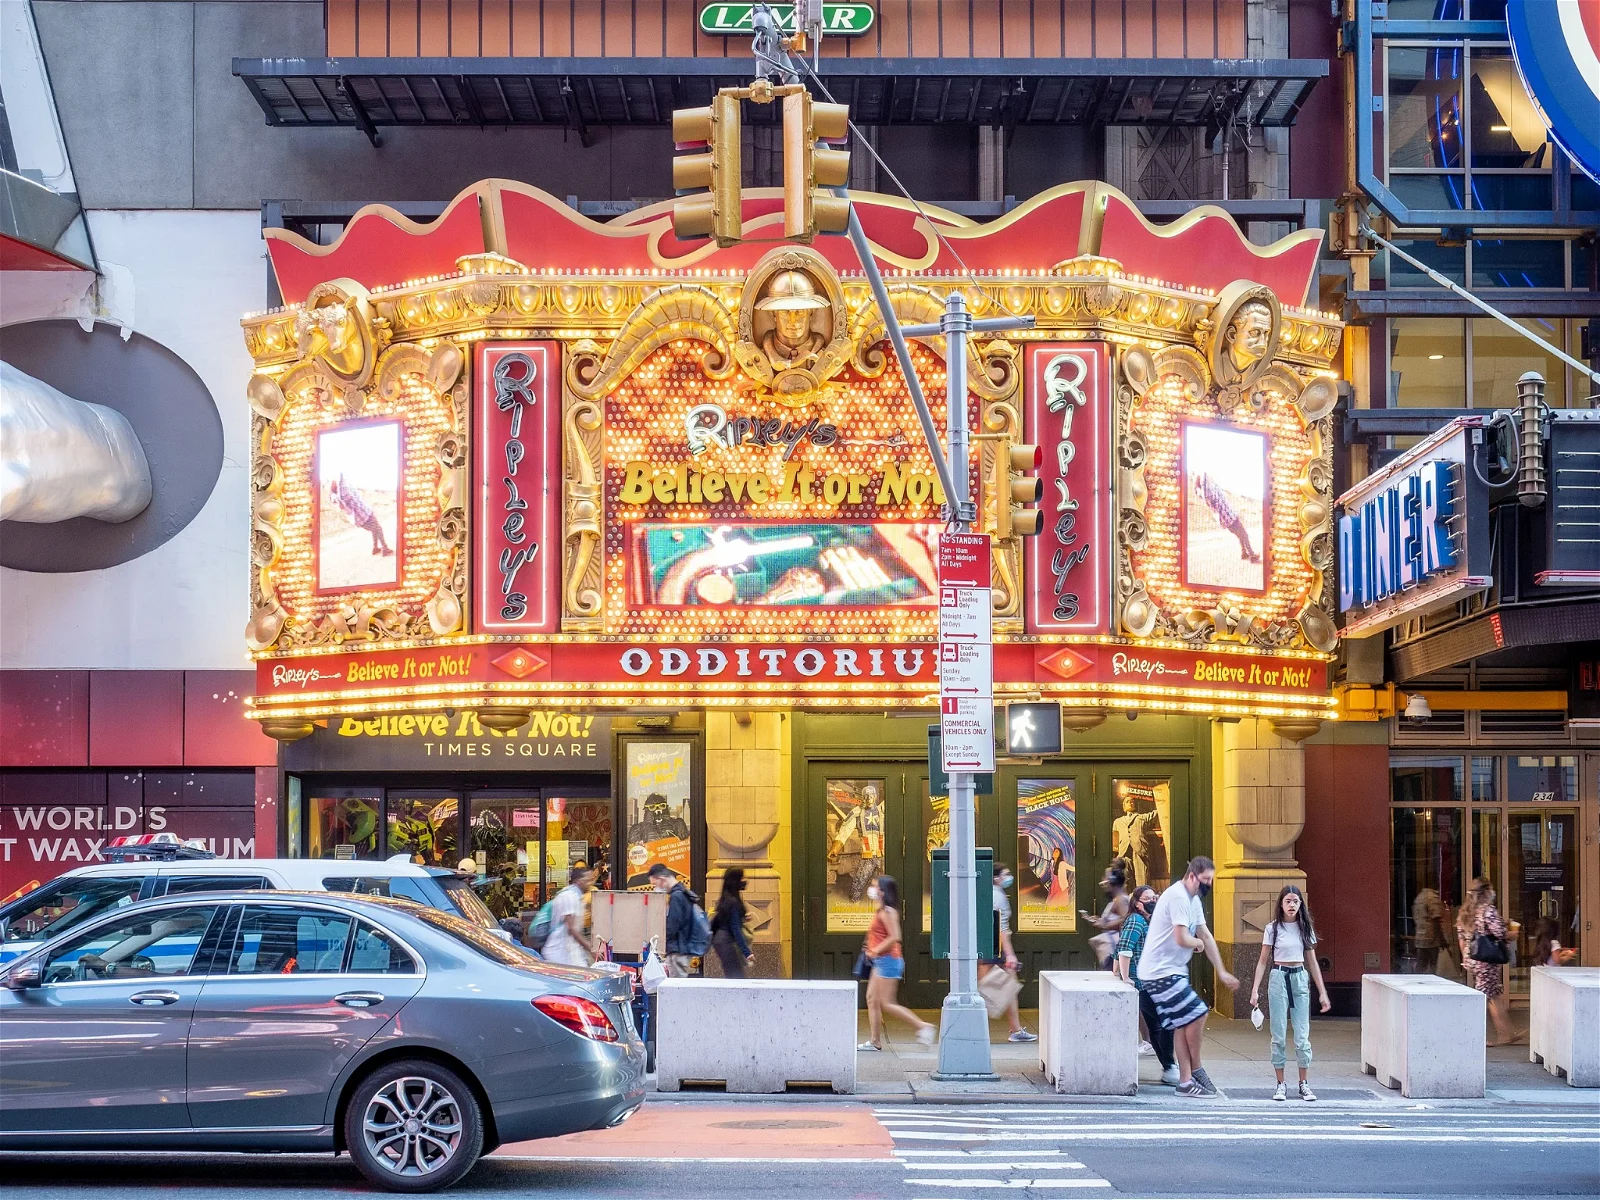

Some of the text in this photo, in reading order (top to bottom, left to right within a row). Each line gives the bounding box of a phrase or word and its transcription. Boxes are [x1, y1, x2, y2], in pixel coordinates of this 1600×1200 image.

[715, 8, 856, 29] LAMR
[684, 403, 837, 462] Ripley's
[493, 352, 539, 620] Ripley's
[618, 460, 772, 505] Believe
[773, 460, 815, 504] It
[823, 470, 871, 505] or
[1043, 353, 1090, 621] Ripley's
[941, 536, 983, 545] NO STANDING
[1339, 460, 1456, 613] DINER
[272, 652, 472, 689] Ripley's Believe It or Not!
[619, 647, 941, 676] ODDITORIU
[1112, 652, 1312, 688] Ripley's Believe It or Not!
[947, 699, 953, 713] 1
[338, 714, 450, 737] Believe
[455, 711, 484, 737] It
[528, 711, 595, 738] Not!
[424, 743, 597, 756] TIMES SQUARE
[1025, 794, 1072, 813] BLACK HOLE!
[13, 806, 167, 831] WORLD'S
[28, 838, 107, 862] WAX
